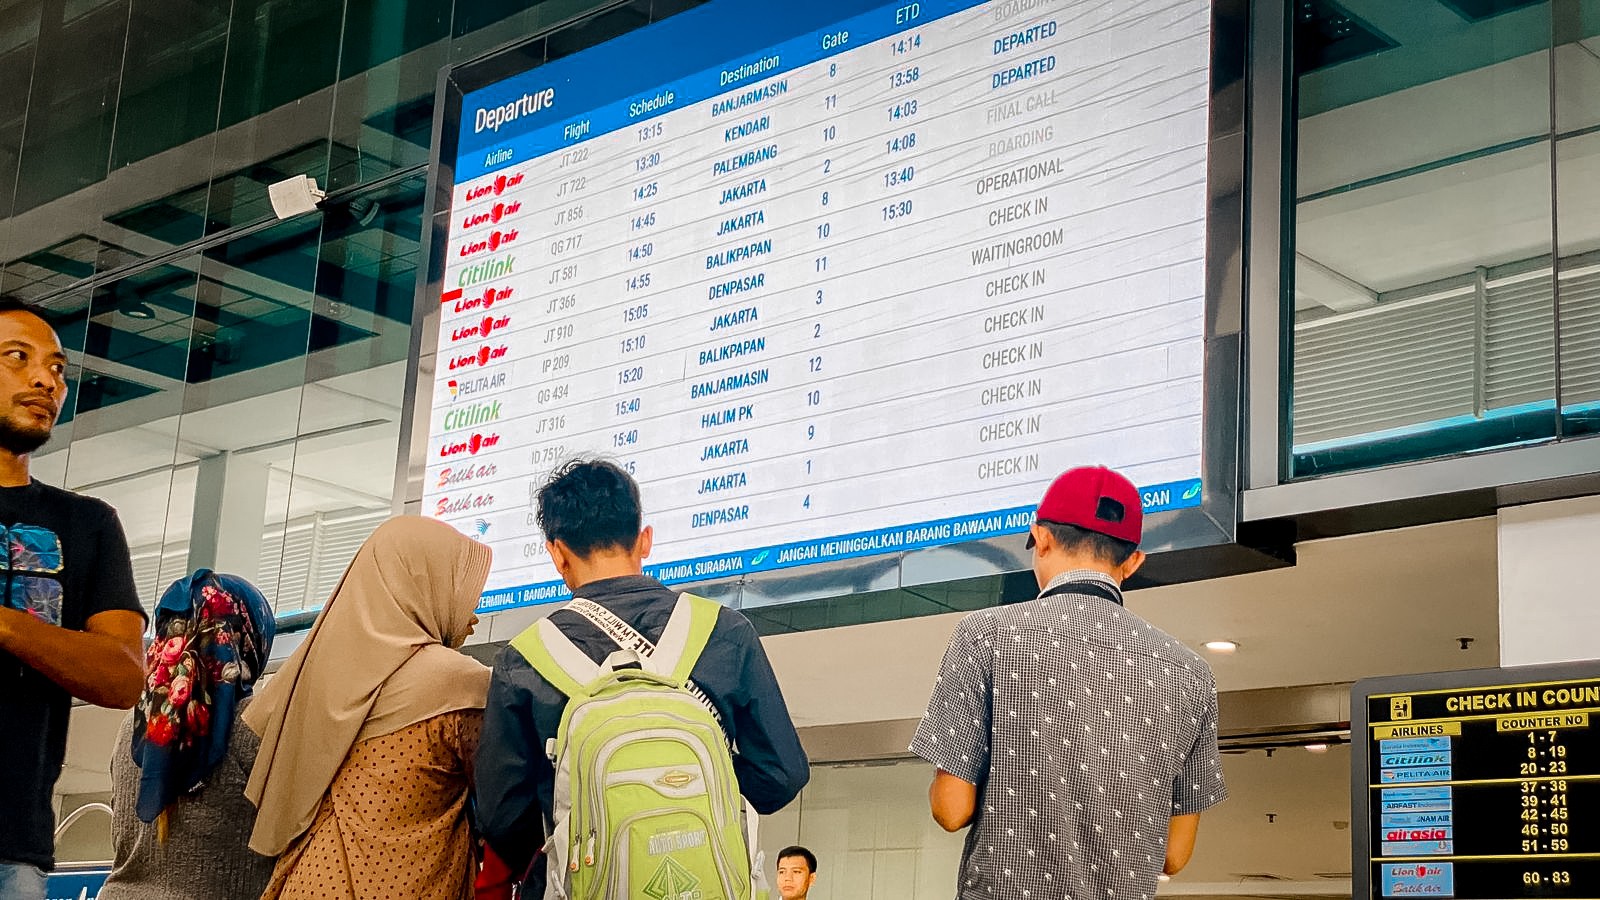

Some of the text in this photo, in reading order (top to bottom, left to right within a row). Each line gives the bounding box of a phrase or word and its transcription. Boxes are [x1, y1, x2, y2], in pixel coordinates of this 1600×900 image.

[896, 3, 920, 24] ETD
[822, 31, 848, 50] Gate
[720, 55, 779, 86] Destination
[475, 88, 554, 133] Departure
[557, 21, 1056, 197] JT 722 13:30 KENDARI 11 13:58 DEPARTED
[560, 153, 570, 168] JT
[573, 148, 588, 166] 222
[638, 122, 662, 142] 13:15
[712, 80, 788, 118] BANJARMASIN
[830, 64, 836, 78] 8
[891, 34, 921, 56] 14:14
[629, 91, 674, 118] Schedule
[554, 211, 566, 226] JT
[568, 206, 583, 222] 856
[633, 182, 658, 202] 14:25
[713, 144, 778, 176] PALEMBANG
[824, 126, 836, 142] 10
[888, 100, 917, 122] 14:03
[992, 56, 1056, 88] DEPARTED
[564, 120, 590, 140] Flight
[485, 149, 513, 168] Airline
[552, 240, 564, 256] QG
[566, 234, 582, 250] 717
[630, 212, 656, 231] 14:45
[720, 178, 766, 205] JAKARTA
[824, 159, 830, 174] 2
[886, 133, 916, 154] 14:08
[986, 100, 1022, 124] FINAL
[1026, 90, 1058, 112] CALL
[550, 126, 1054, 284] JT 581 14:50 JAKARTA 8 13:40 BOARDING
[547, 158, 1064, 314] JT 366 14:55 BALIKPAPAN 10 15:30 OPERATIONAL
[544, 329, 555, 344] JT
[557, 324, 574, 340] 910
[624, 304, 648, 323] 15:05
[709, 273, 764, 300] DENPASAR
[816, 256, 826, 272] 11
[989, 200, 1031, 226] CHECK
[1035, 196, 1048, 215] IN
[459, 228, 1063, 396] PELITA AIR IP 209 15:10 JAKARTA 3 WAITINGROOM
[538, 390, 550, 404] QG
[552, 384, 568, 399] 434
[618, 366, 642, 384] 15:20
[700, 337, 765, 366] BALIKPAPAN
[814, 324, 820, 338] 2
[986, 272, 1029, 297] CHECK
[1032, 268, 1044, 286] IN
[536, 304, 1044, 434] JT 316 15:40 BANJARMASIN 12 CHECK IN
[532, 451, 540, 464] ID
[543, 446, 564, 462] 7512
[614, 430, 638, 448] 15:40
[702, 409, 736, 428] HALIM
[738, 404, 754, 421] PK
[808, 390, 820, 406] 10
[983, 344, 1026, 369] CHECK
[1030, 342, 1042, 360] IN
[700, 438, 749, 461] JAKARTA
[808, 425, 814, 440] 9
[982, 382, 1024, 406] CHECK
[1028, 378, 1041, 396] IN
[698, 414, 1040, 494] JAKARTA 1 CHECK IN
[692, 454, 1038, 528] DENPASAR 4 CHECK IN
[1143, 490, 1170, 508] SAN
[777, 510, 1036, 564] JANGAN MENINGGALKAN BARANG BAWAAN ANDA
[658, 566, 692, 580] JUANDA
[695, 556, 743, 574] SURABAYA
[478, 592, 514, 609] TERMINAL
[518, 590, 522, 603] 1
[524, 586, 556, 602] BANDAR
[1446, 686, 1600, 712] CHECK IN COUN
[1392, 725, 1444, 736] AIRLINES
[1502, 716, 1583, 729] COUNTER NO
[1528, 731, 1556, 744] 1 7
[1528, 746, 1566, 758] 8 19
[1520, 762, 1566, 774] 20 23
[1521, 780, 1566, 792] 37 38
[1522, 794, 1566, 806] 39 41
[1521, 808, 1568, 820] 42 45
[1522, 823, 1568, 835] 46 50
[1522, 839, 1568, 852] 51 59
[1523, 872, 1570, 884] 60 83
